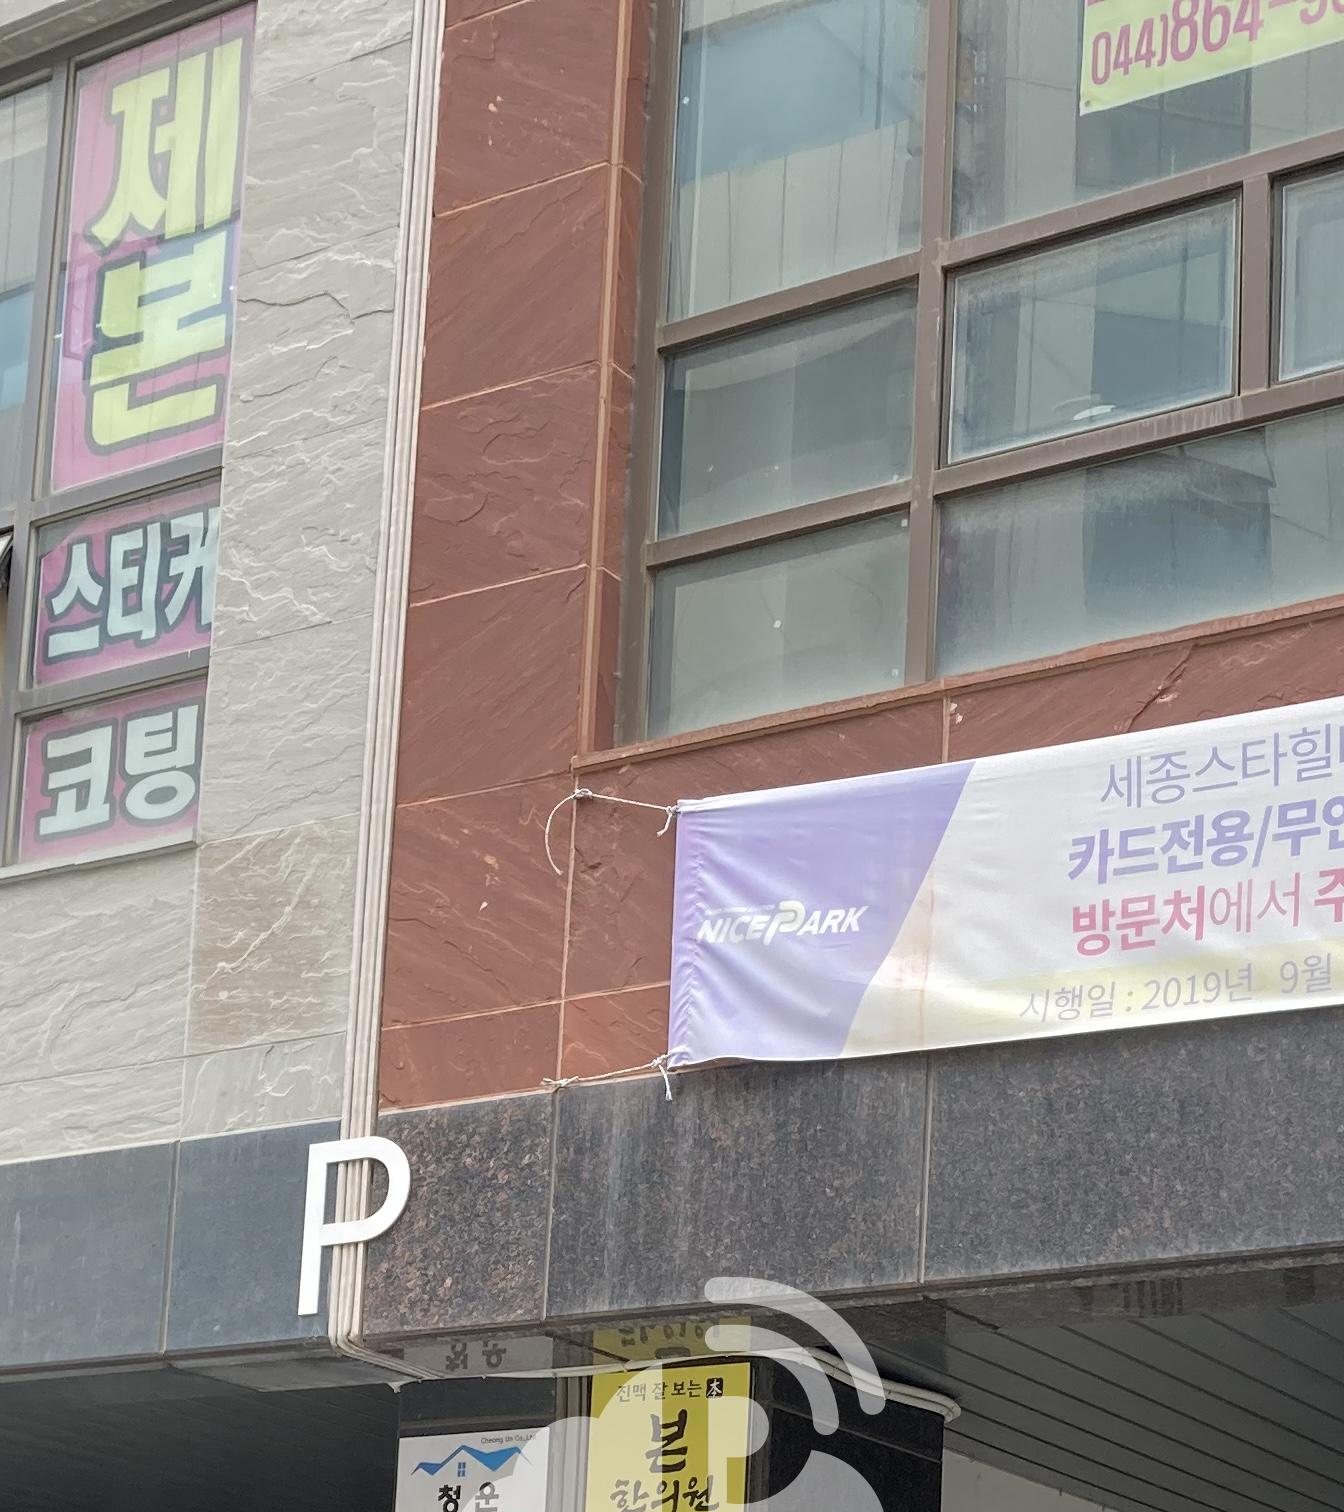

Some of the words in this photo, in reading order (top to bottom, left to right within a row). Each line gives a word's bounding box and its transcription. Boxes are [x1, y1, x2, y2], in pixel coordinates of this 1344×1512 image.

[40, 705, 199, 835] 코팅
[696, 900, 870, 946] NICEPARK
[1071, 873, 1302, 957] 방문처에서
[1018, 980, 1115, 1024] 시행일
[1141, 961, 1254, 1011] 2019년
[1280, 953, 1332, 996] 9월
[298, 1136, 411, 1316] P
[671, 1380, 702, 1398] 보는
[645, 1408, 688, 1474] 본
